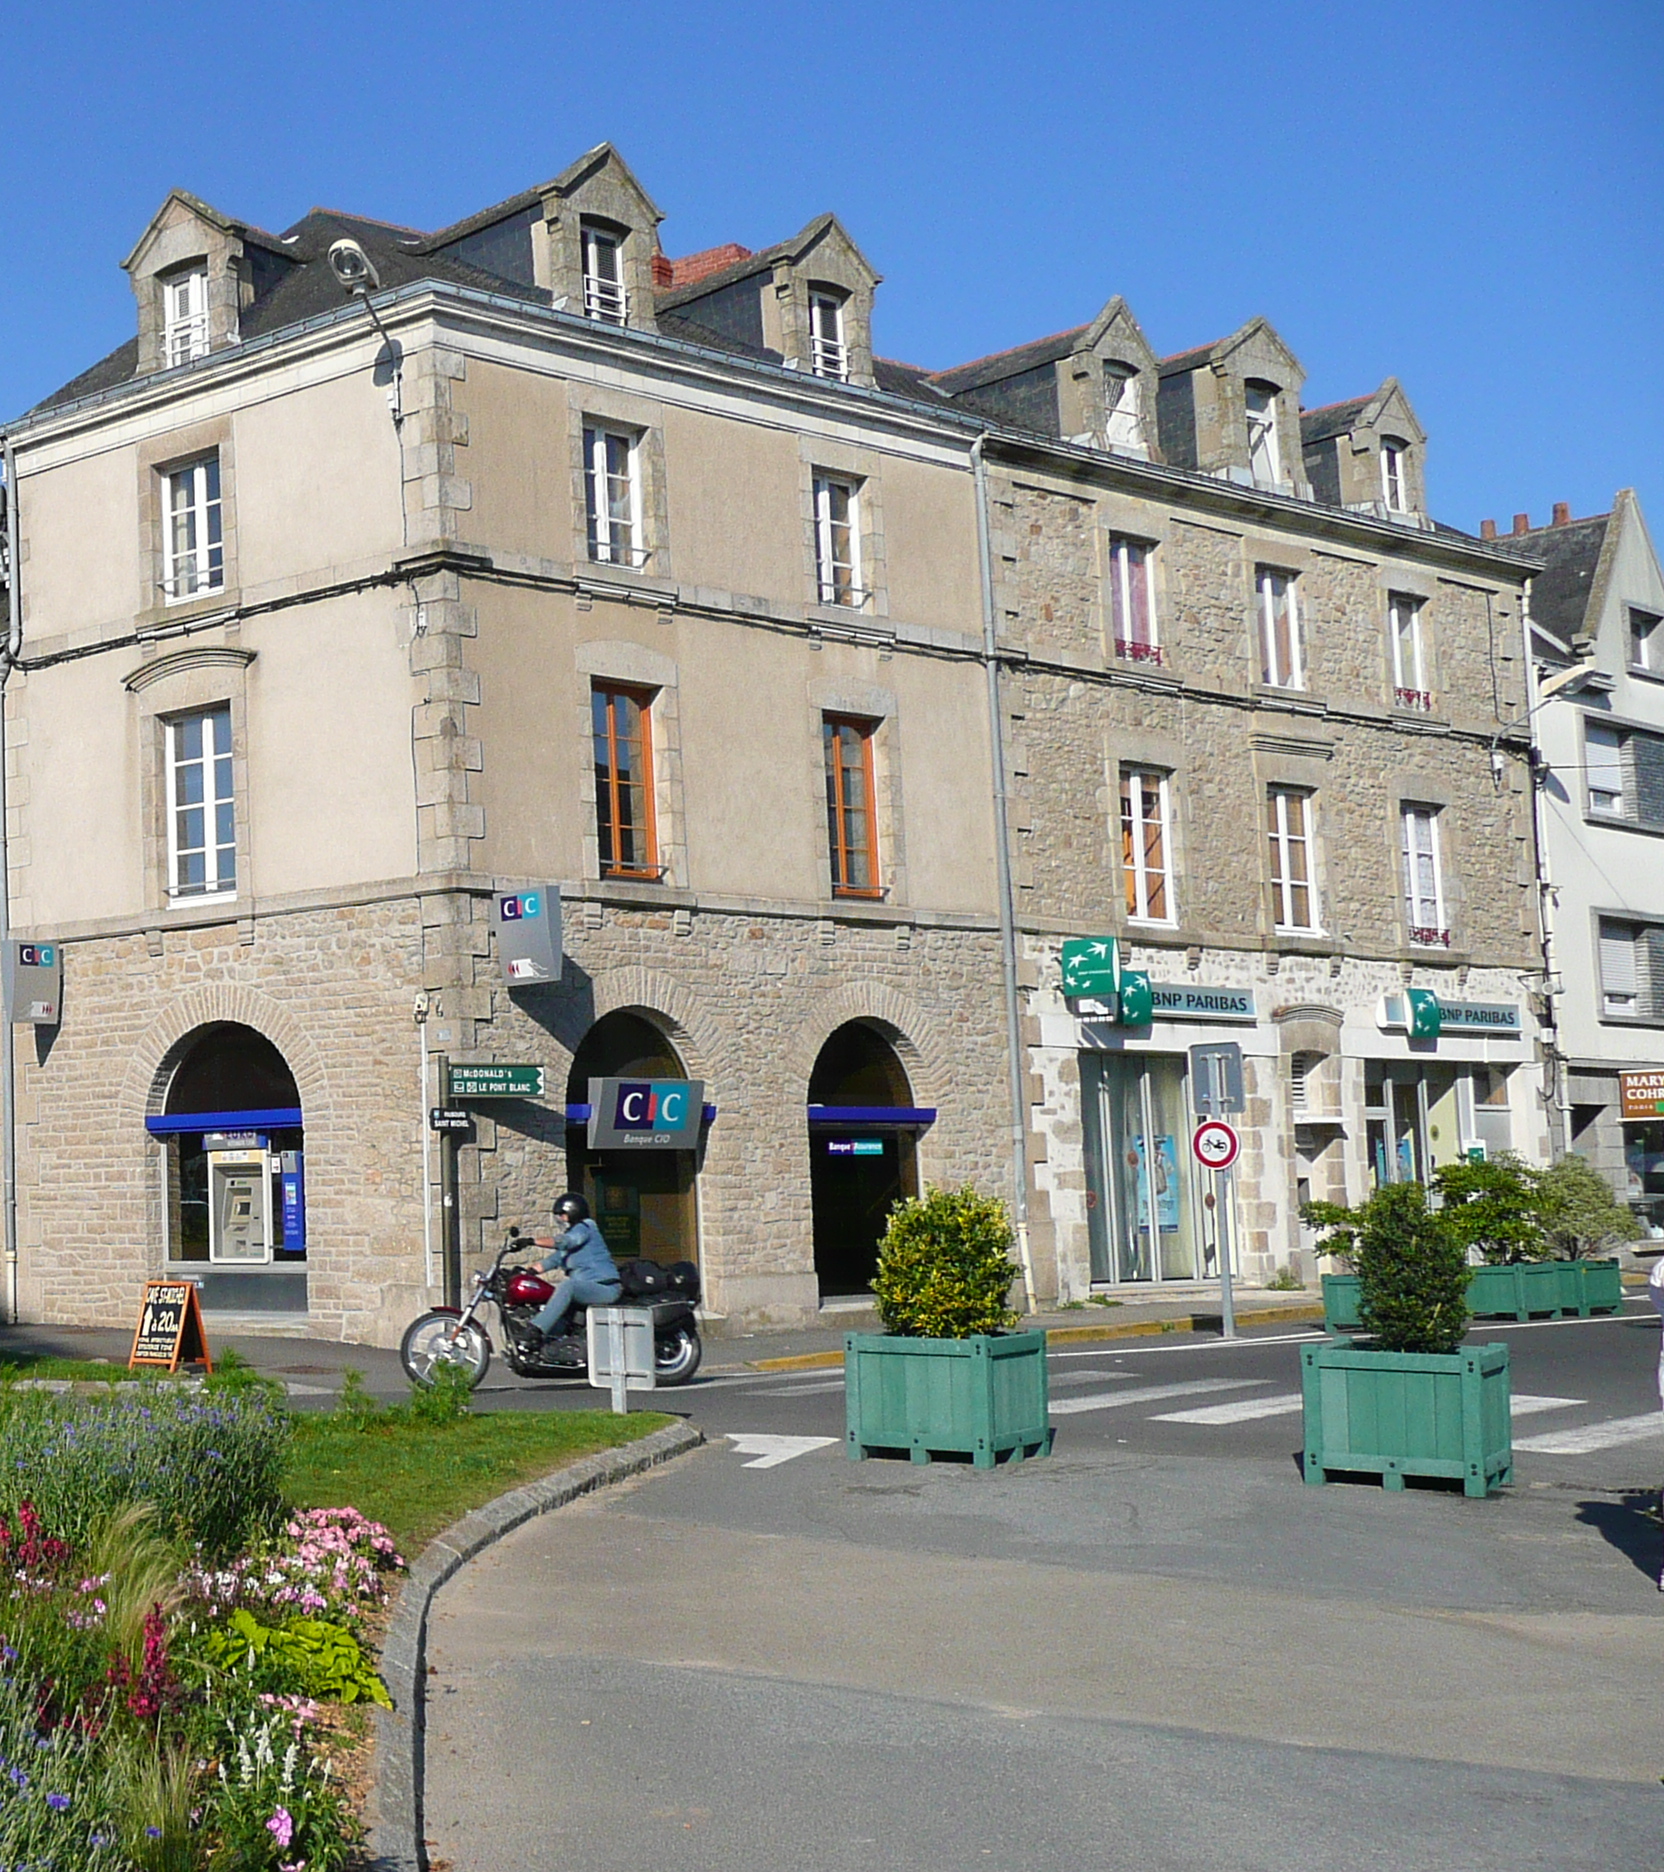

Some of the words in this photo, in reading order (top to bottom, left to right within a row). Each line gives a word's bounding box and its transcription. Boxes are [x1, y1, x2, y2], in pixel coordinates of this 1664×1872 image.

[504, 897, 536, 916] CIC
[23, 948, 51, 964] CIC
[1151, 992, 1182, 1007] BNP
[1186, 994, 1247, 1011] PARIBAS
[1439, 1008, 1462, 1021] BNP
[1465, 1009, 1515, 1025] PARIBAS
[463, 1068, 512, 1078] McDONALD's
[478, 1083, 487, 1092] LE
[490, 1083, 507, 1092] PONT
[509, 1083, 531, 1092] BLANC
[622, 1092, 681, 1122] CIC
[623, 1133, 652, 1145] Banque
